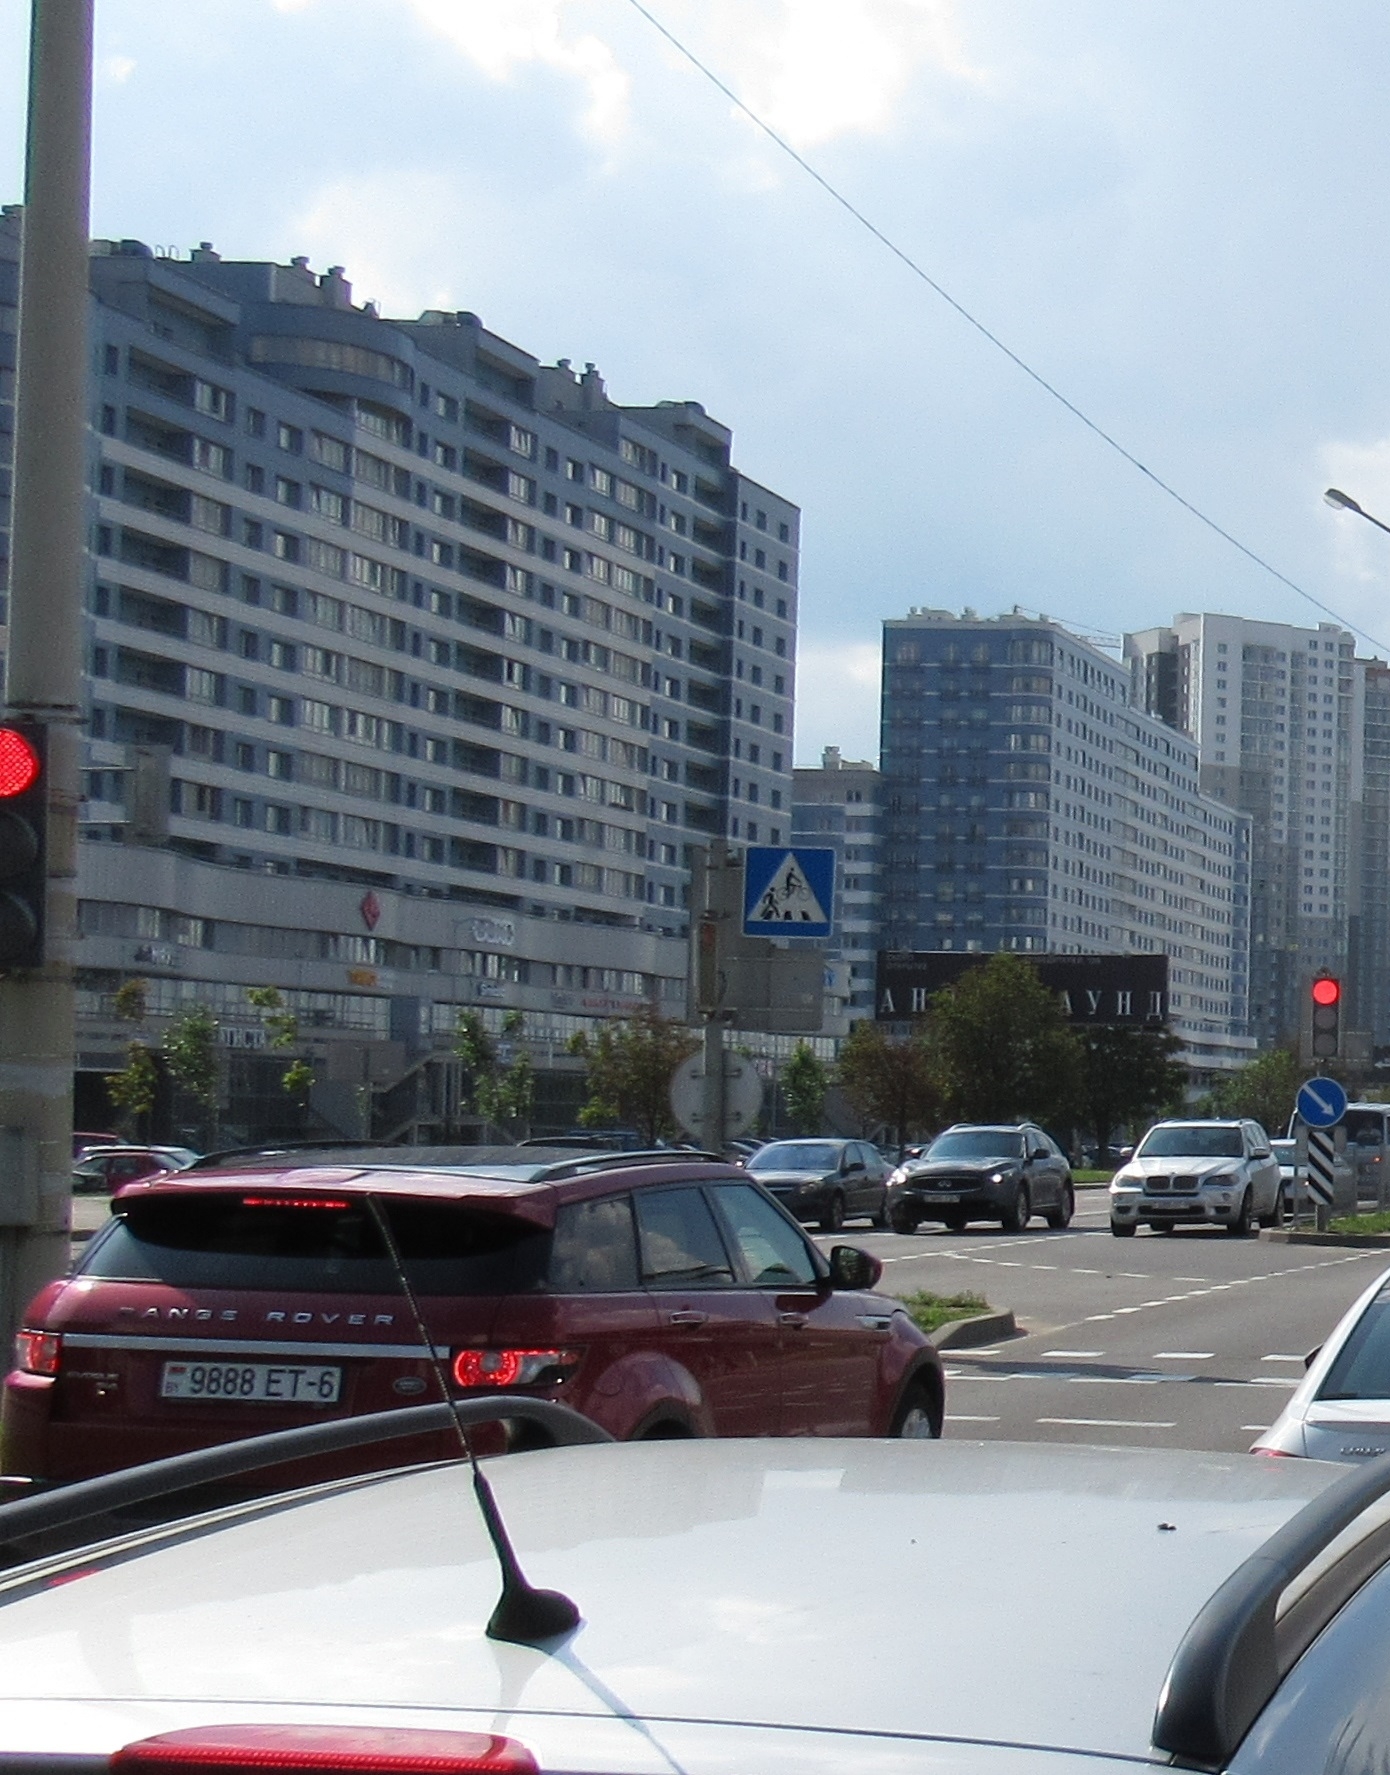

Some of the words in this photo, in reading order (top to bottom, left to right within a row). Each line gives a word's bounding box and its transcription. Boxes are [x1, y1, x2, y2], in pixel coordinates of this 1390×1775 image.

[265, 1310, 394, 1326] ROVER
[189, 1366, 256, 1396] 9888
[265, 1368, 335, 1400] ET-6
